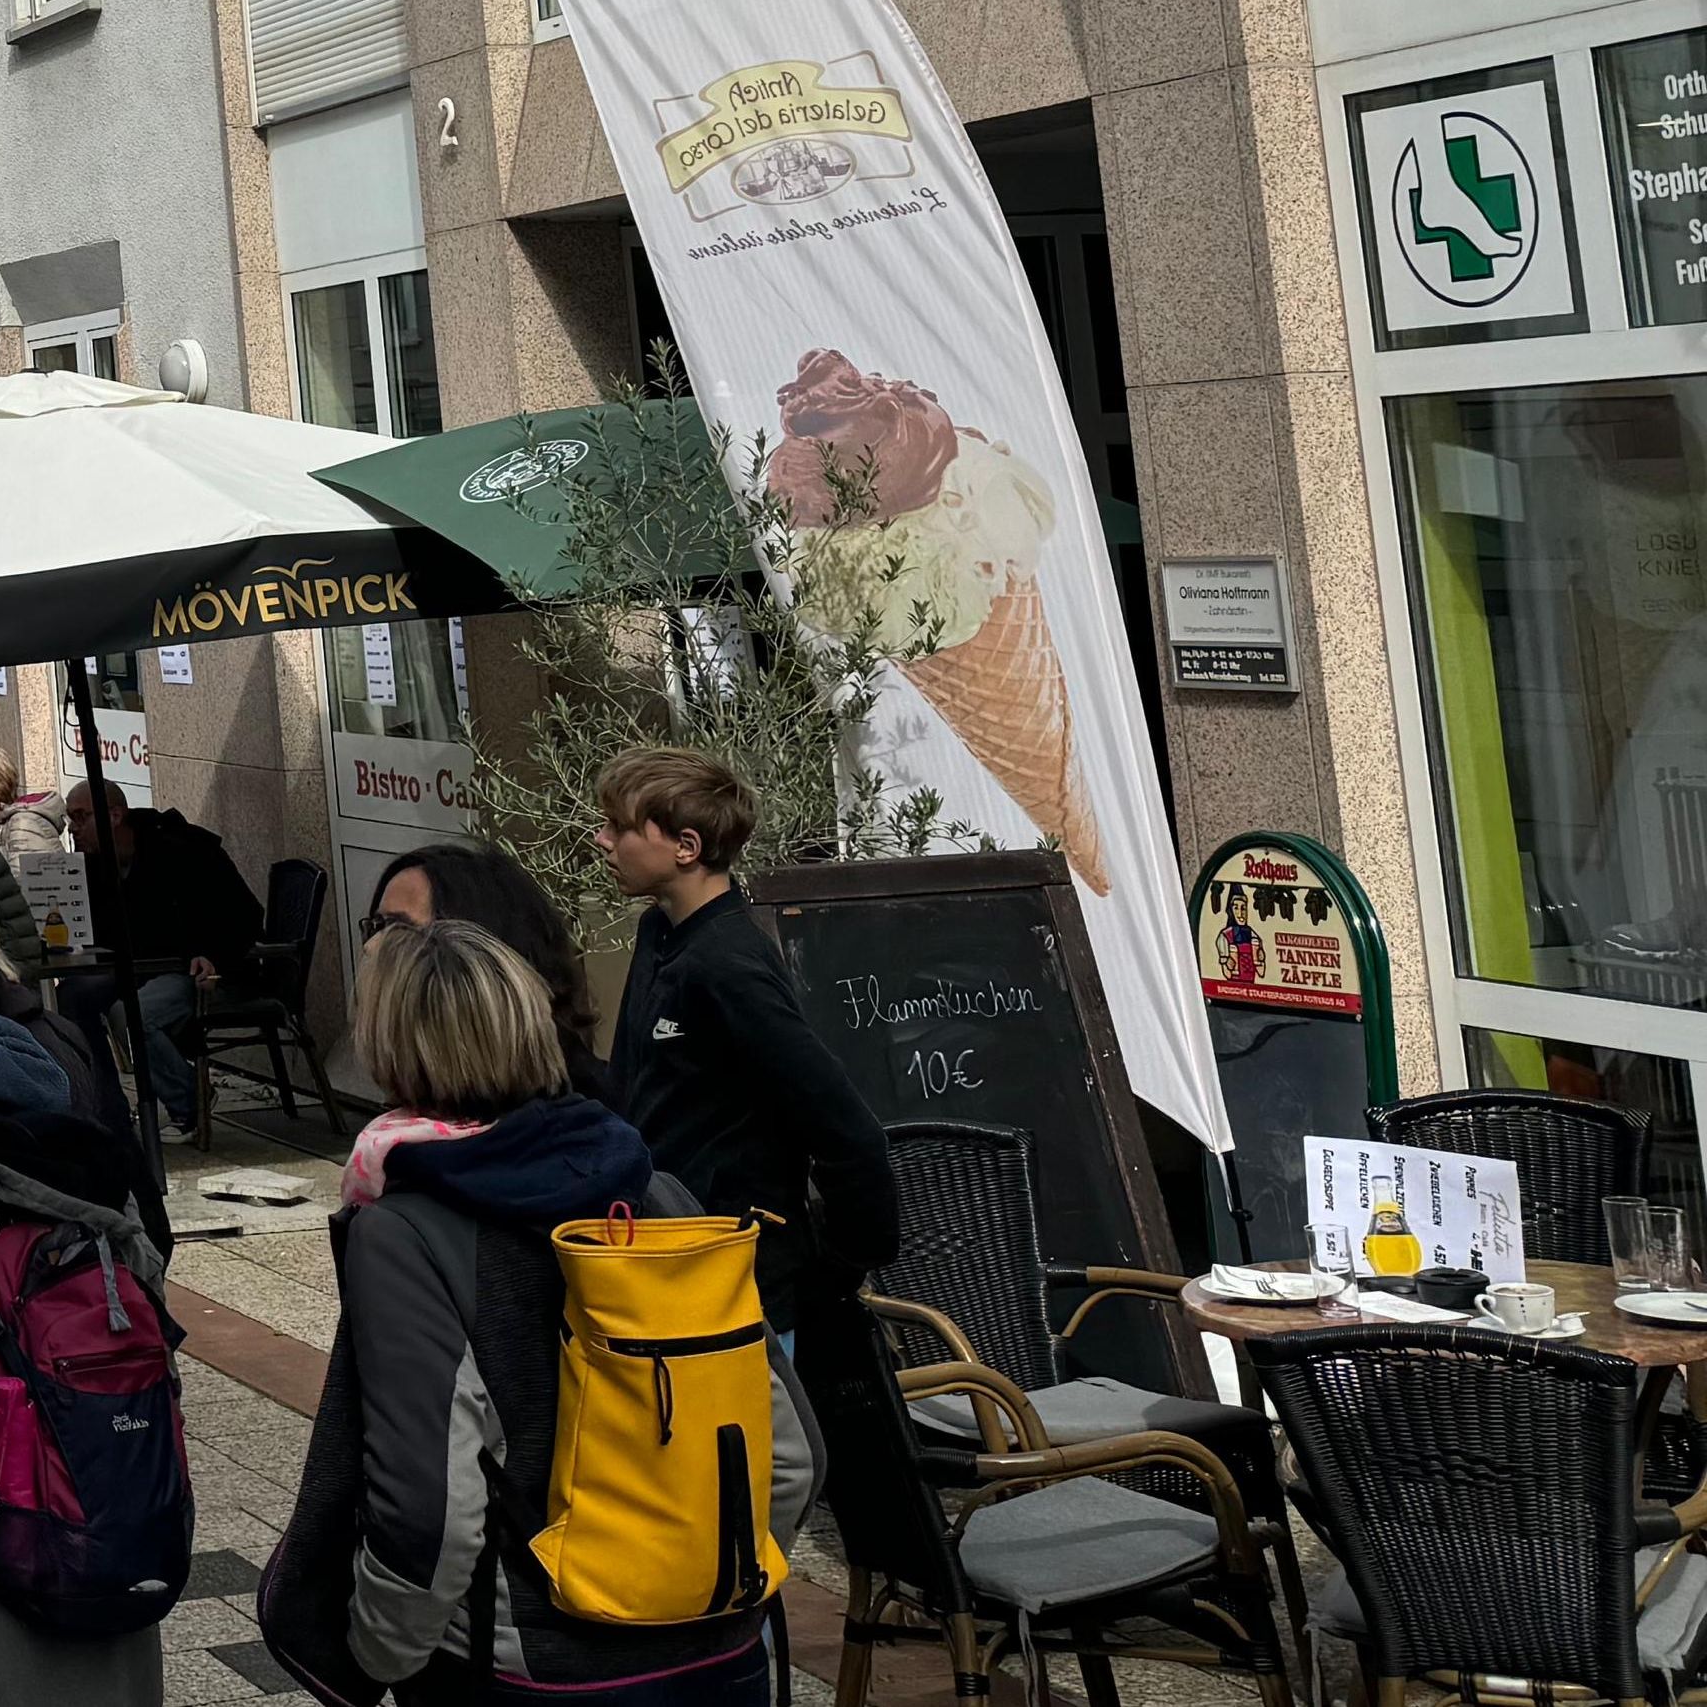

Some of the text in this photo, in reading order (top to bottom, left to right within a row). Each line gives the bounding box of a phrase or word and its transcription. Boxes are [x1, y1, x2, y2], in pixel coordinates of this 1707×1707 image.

[438, 97, 459, 146] 2
[152, 572, 417, 637] MÖVENPICK
[353, 760, 421, 803] Bistro
[1243, 853, 1298, 884] Rothaus
[1276, 948, 1341, 969] TANNEN
[1281, 966, 1342, 988] ZÄPFLE
[907, 1049, 984, 1098] 10€
